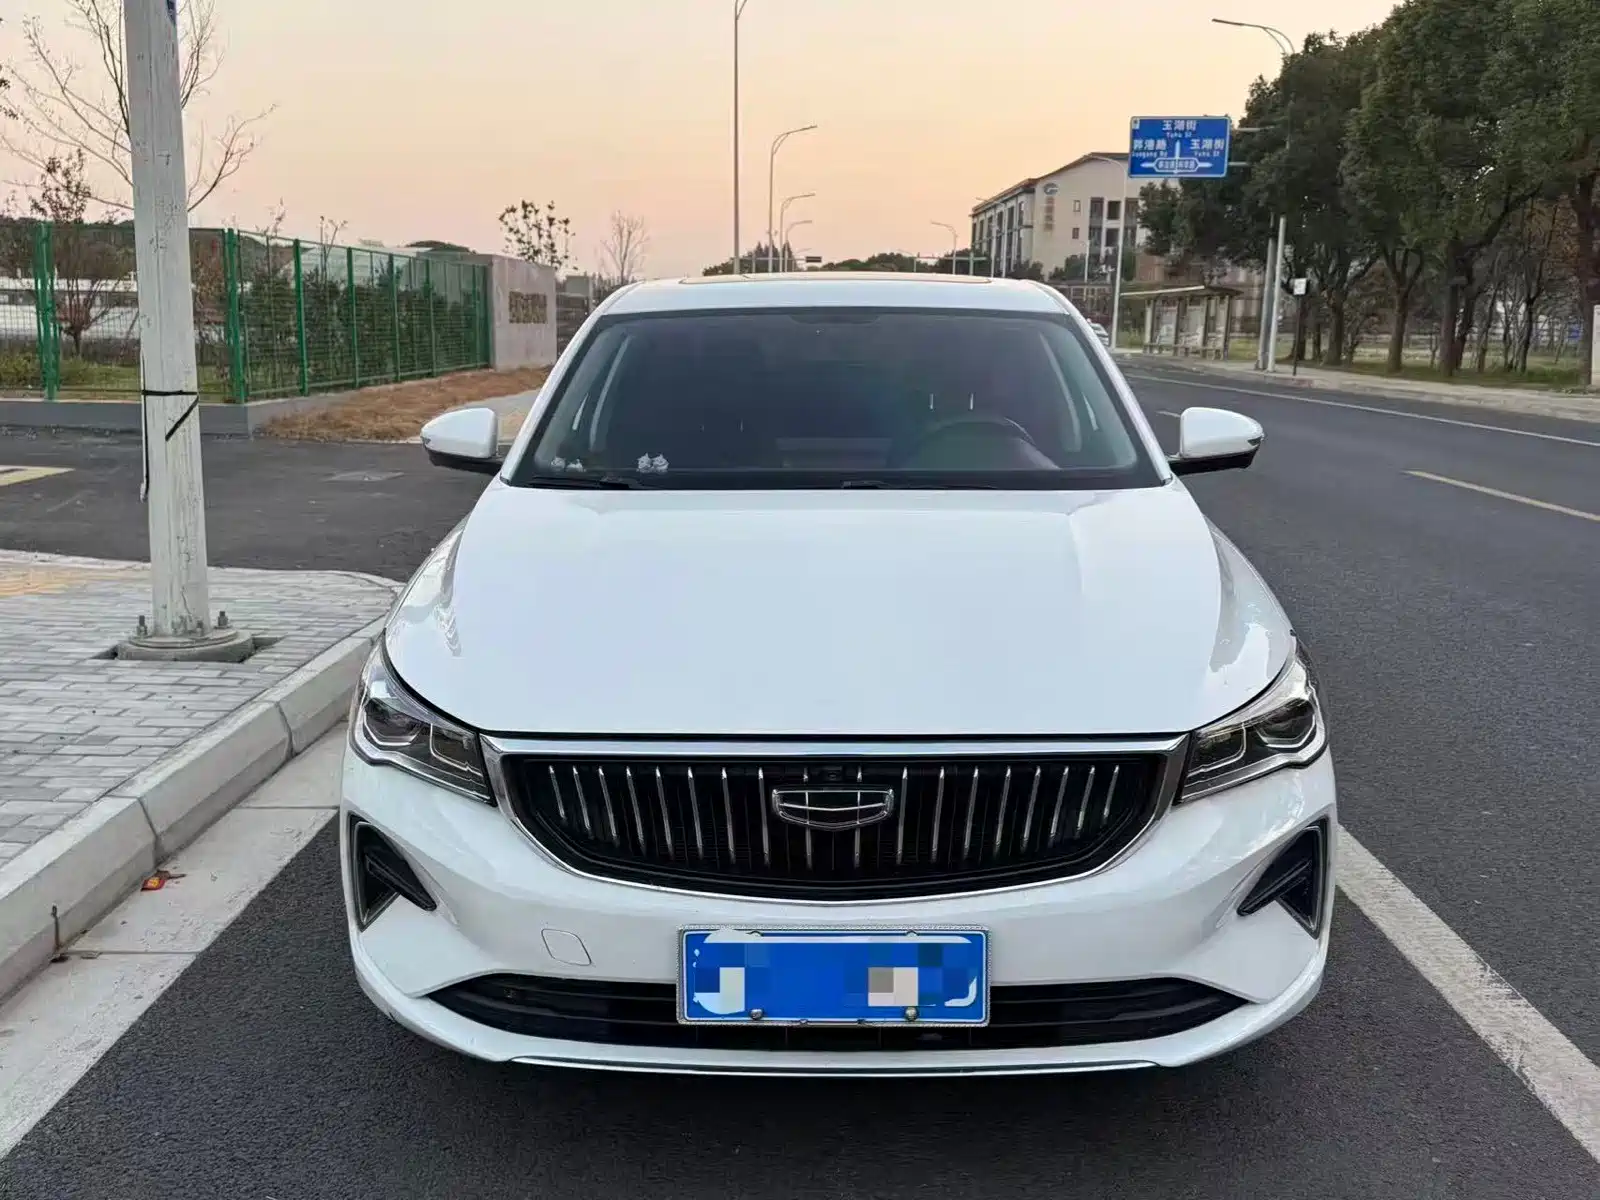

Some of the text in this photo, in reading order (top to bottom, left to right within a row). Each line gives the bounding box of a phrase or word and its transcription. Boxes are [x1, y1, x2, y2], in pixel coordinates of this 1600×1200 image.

[1162, 119, 1197, 131] 玉湖街
[1190, 139, 1225, 150] 玉湖街
